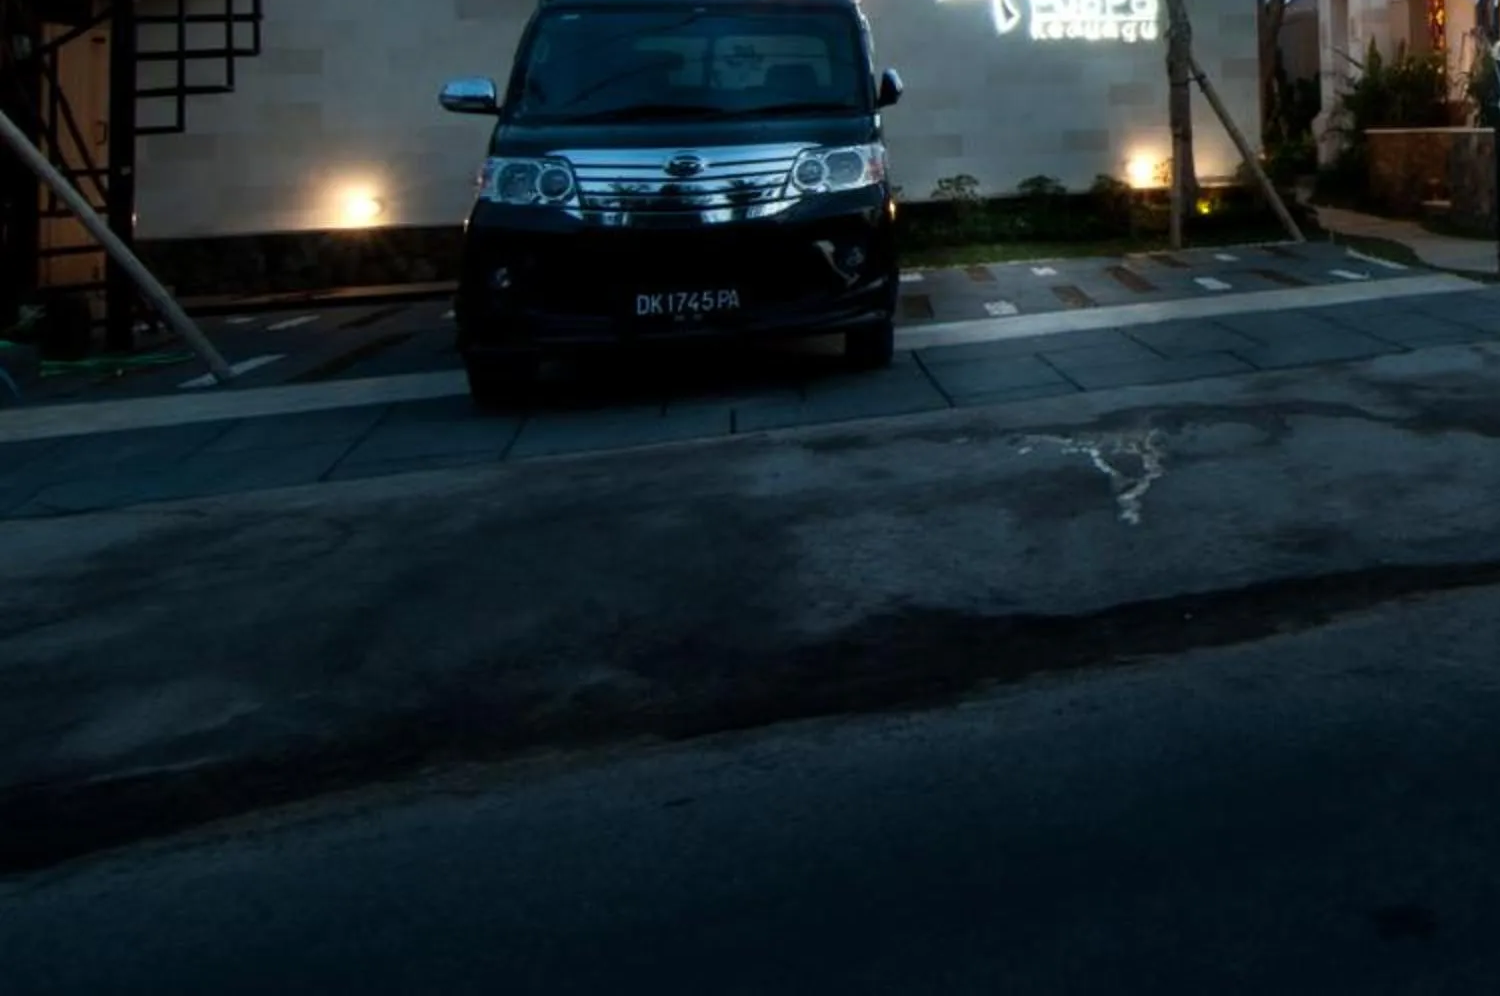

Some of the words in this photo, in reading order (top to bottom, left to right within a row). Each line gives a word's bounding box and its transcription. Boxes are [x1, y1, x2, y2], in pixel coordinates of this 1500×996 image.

[636, 293, 664, 316] DK
[667, 290, 715, 312] 1745
[717, 288, 741, 309] PA
